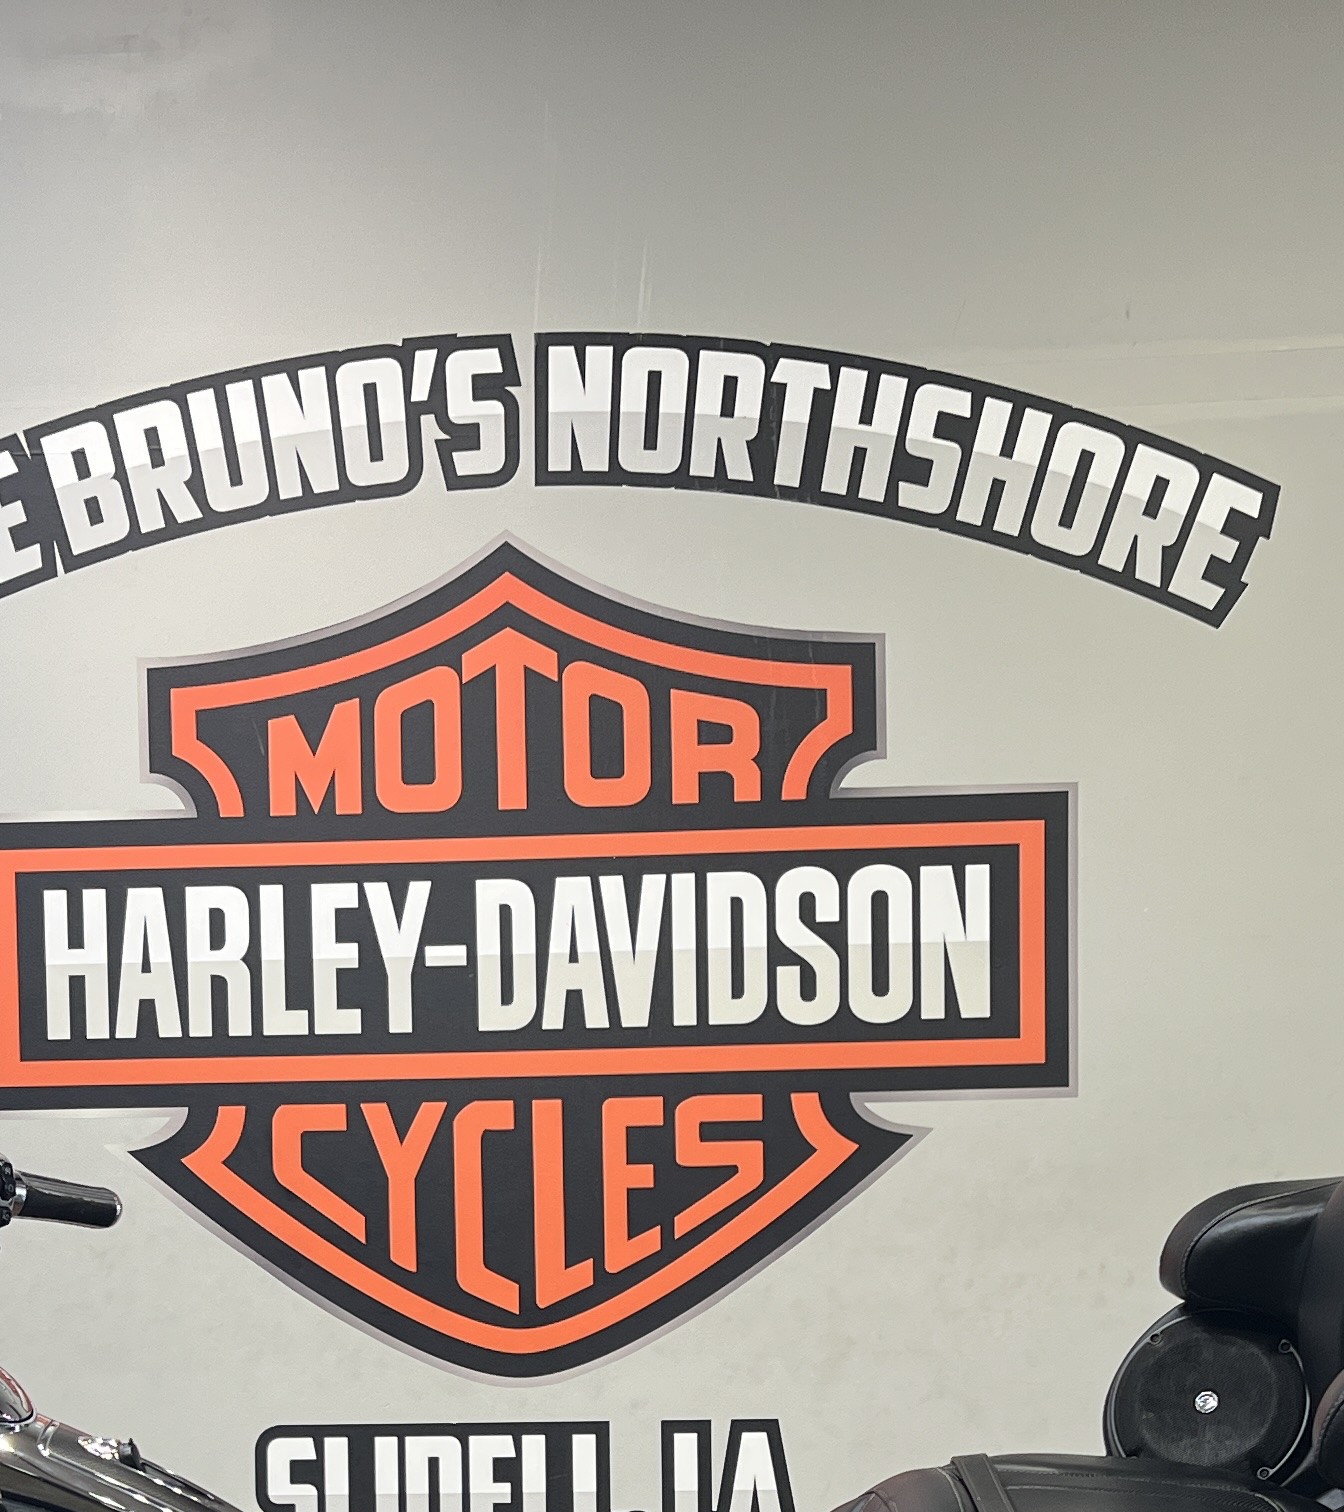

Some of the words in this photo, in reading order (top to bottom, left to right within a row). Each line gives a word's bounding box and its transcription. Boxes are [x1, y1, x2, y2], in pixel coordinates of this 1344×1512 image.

[40, 347, 508, 556] BRUNO'S
[546, 345, 1264, 611] NORTHSHORE
[268, 626, 761, 817] MOTOR
[42, 863, 992, 1041] HARLEY-DAVIDSON
[271, 1094, 764, 1315] CYCLES
